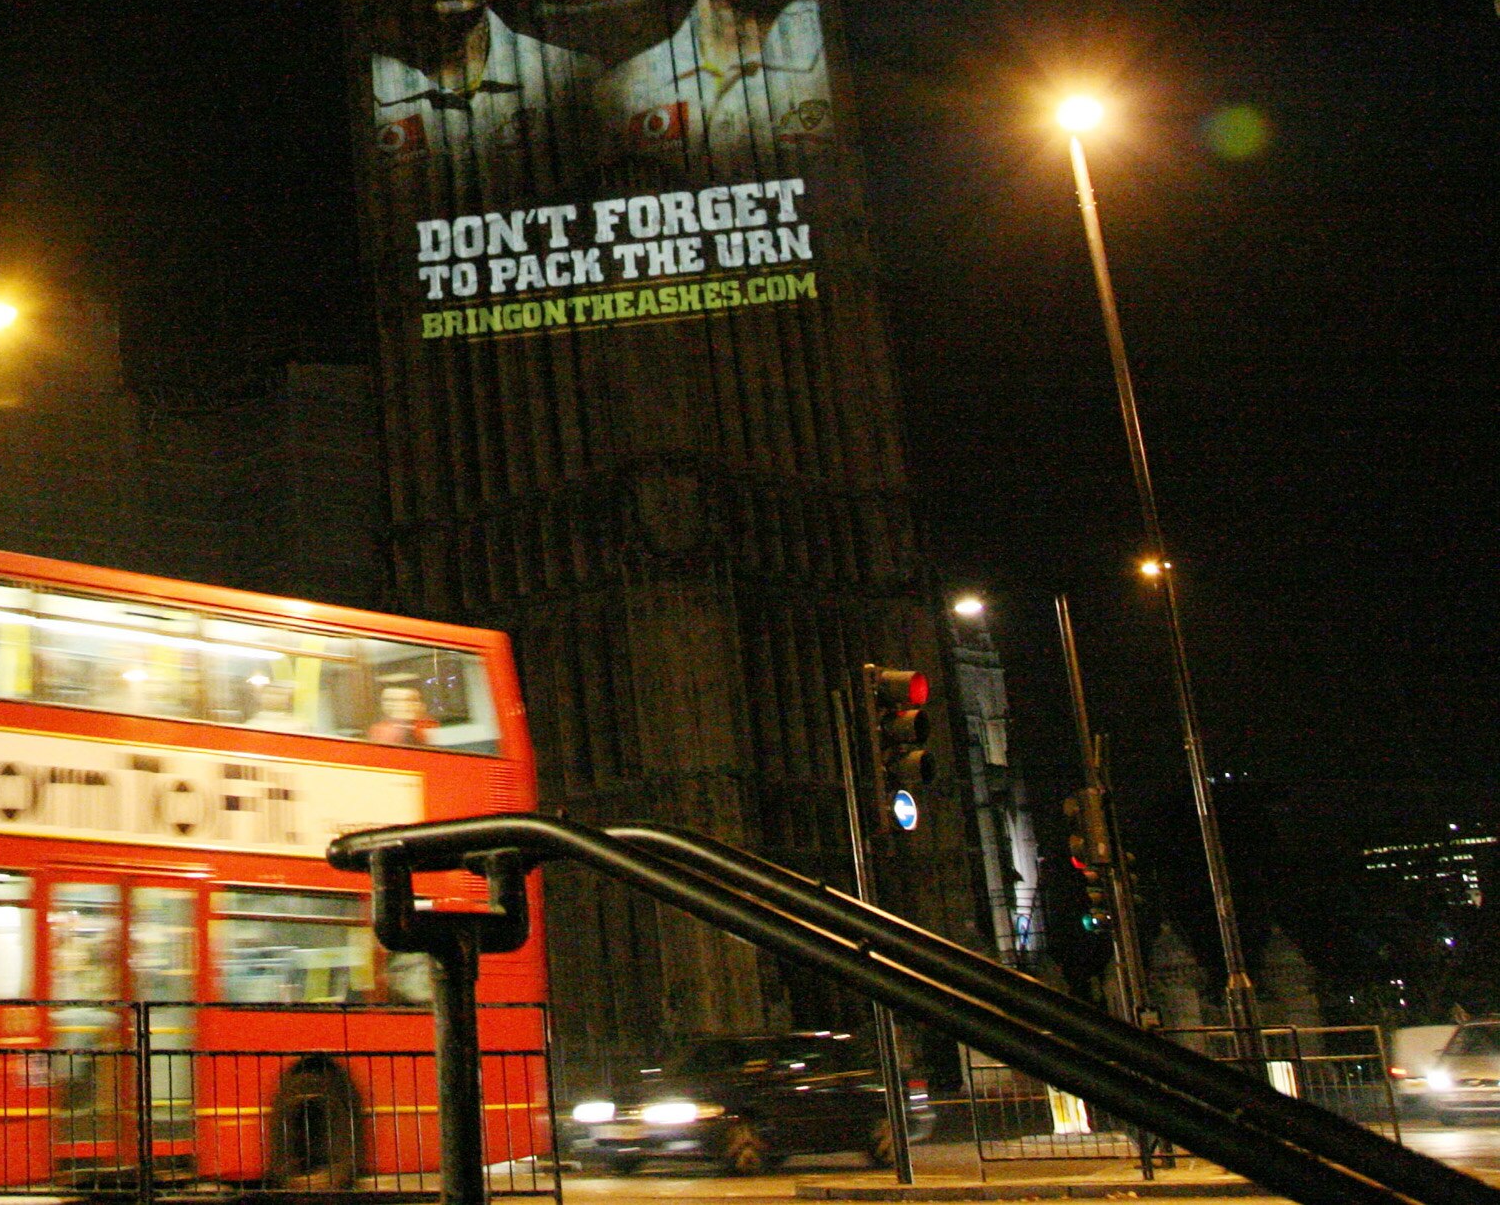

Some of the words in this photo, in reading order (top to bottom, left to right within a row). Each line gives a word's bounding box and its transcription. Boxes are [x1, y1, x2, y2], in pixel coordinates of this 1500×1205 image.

[416, 204, 578, 264] DON'T
[592, 177, 807, 242] FORGET
[417, 258, 478, 300] TO
[488, 247, 604, 294] PACK
[613, 240, 705, 280] THE
[715, 224, 814, 269] URN
[420, 270, 820, 340] BRINGONTHEASHES.COM
